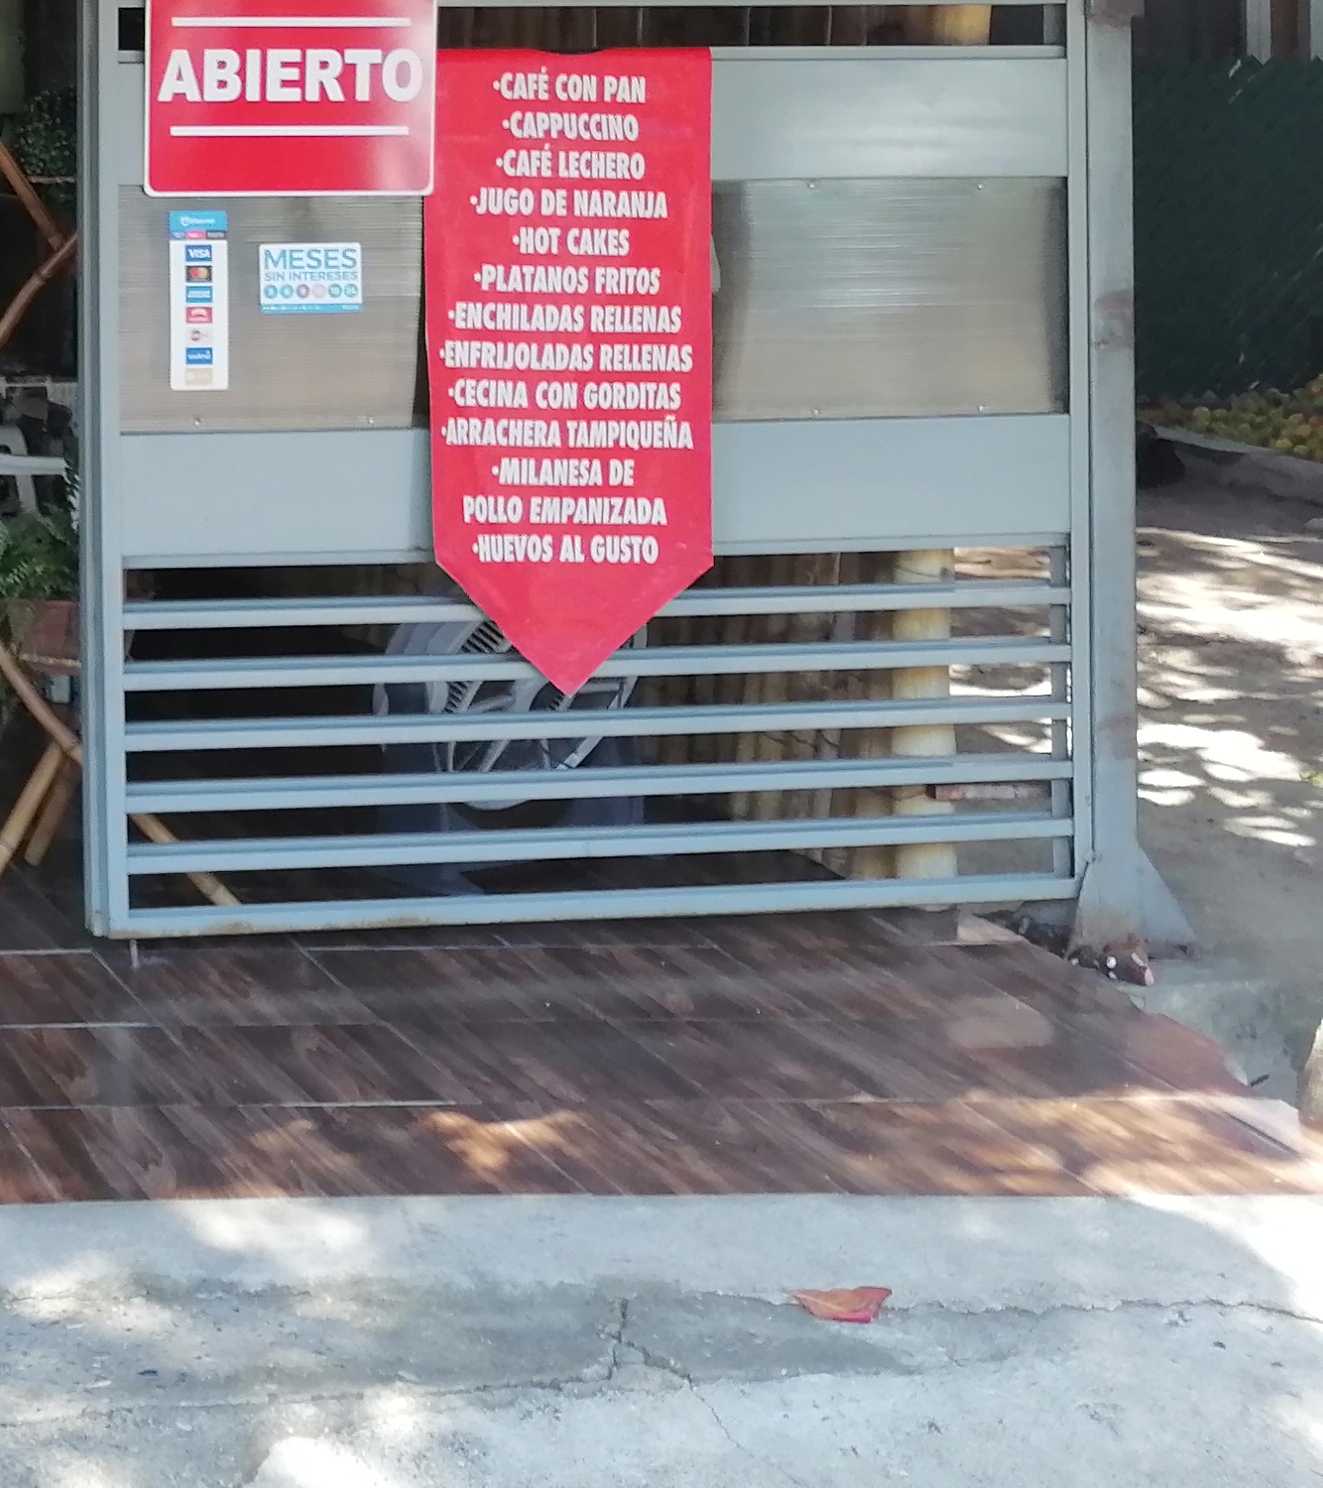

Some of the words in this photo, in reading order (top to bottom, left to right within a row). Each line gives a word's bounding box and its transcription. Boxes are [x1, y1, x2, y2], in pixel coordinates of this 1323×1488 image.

[157, 48, 424, 102] ABIERTO
[556, 73, 597, 101] CON
[604, 76, 646, 103] PAN
[559, 150, 645, 179] LECHERO
[541, 189, 566, 216] DE
[574, 190, 667, 218] NARANJA
[567, 228, 630, 256] CAKES
[264, 248, 357, 270] MESES
[264, 271, 285, 282] SIN
[289, 271, 358, 282] INTERESES
[595, 267, 660, 295] FRITOS
[590, 305, 681, 333] RELLENAS
[599, 344, 693, 372] RELLENAS
[535, 381, 577, 409] CON
[583, 382, 681, 410] GORDITAS
[567, 415, 693, 451] TAMPIQUEÑA
[609, 459, 635, 487] DE
[463, 495, 523, 524] POLLO
[529, 496, 667, 526] EMPANIZADA
[559, 535, 585, 563] AL
[590, 535, 659, 564] GUSTO
